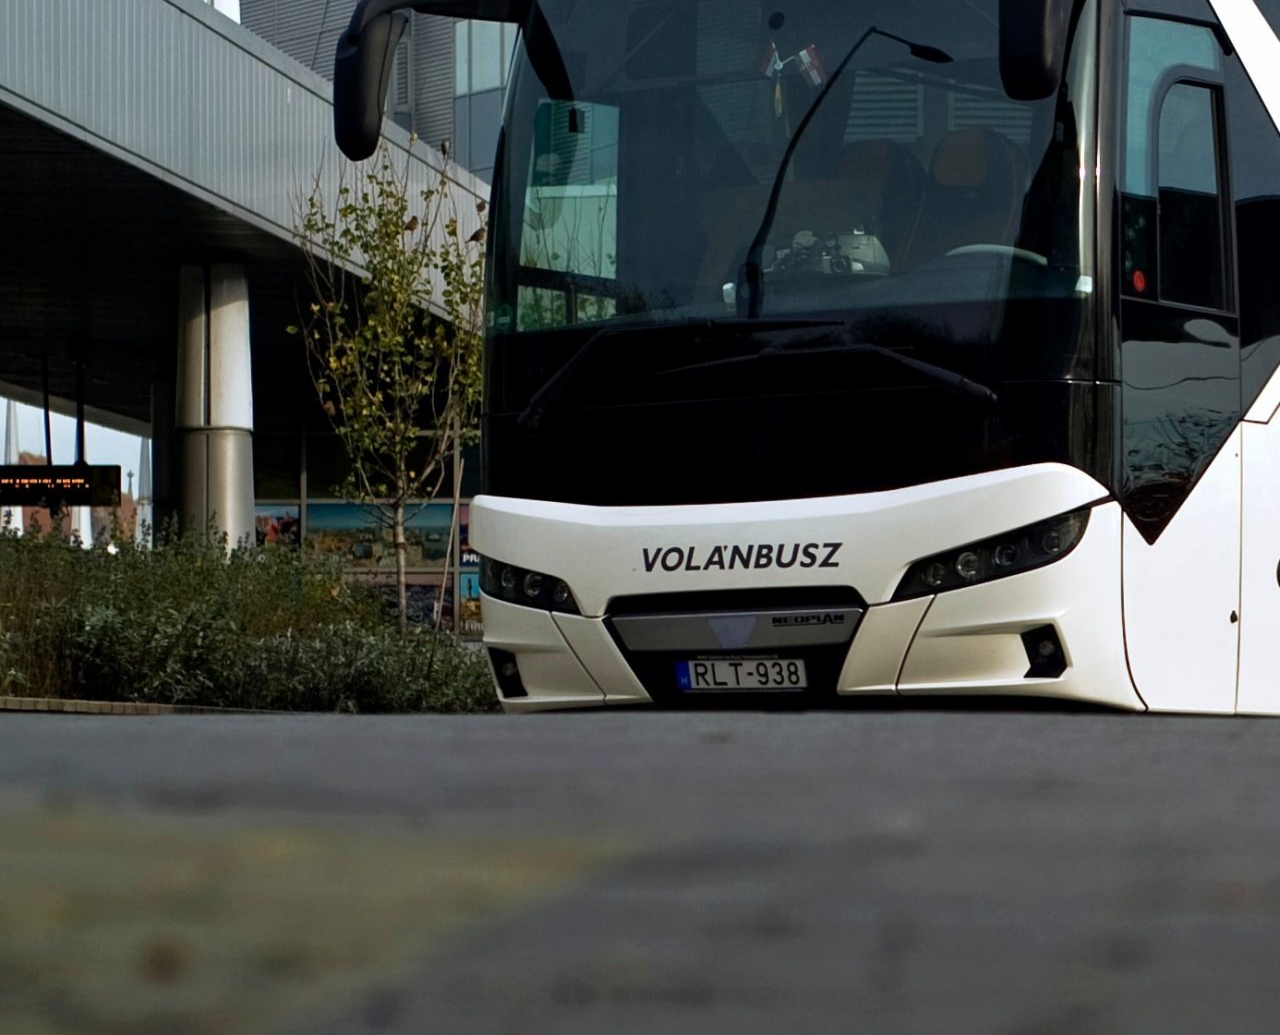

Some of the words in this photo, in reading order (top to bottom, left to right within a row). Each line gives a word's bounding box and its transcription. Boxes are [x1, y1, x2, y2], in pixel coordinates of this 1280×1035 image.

[642, 542, 843, 572] VOLÁNBUSZ
[772, 614, 845, 625] NEOPLAN
[693, 662, 800, 686] RLT-938
